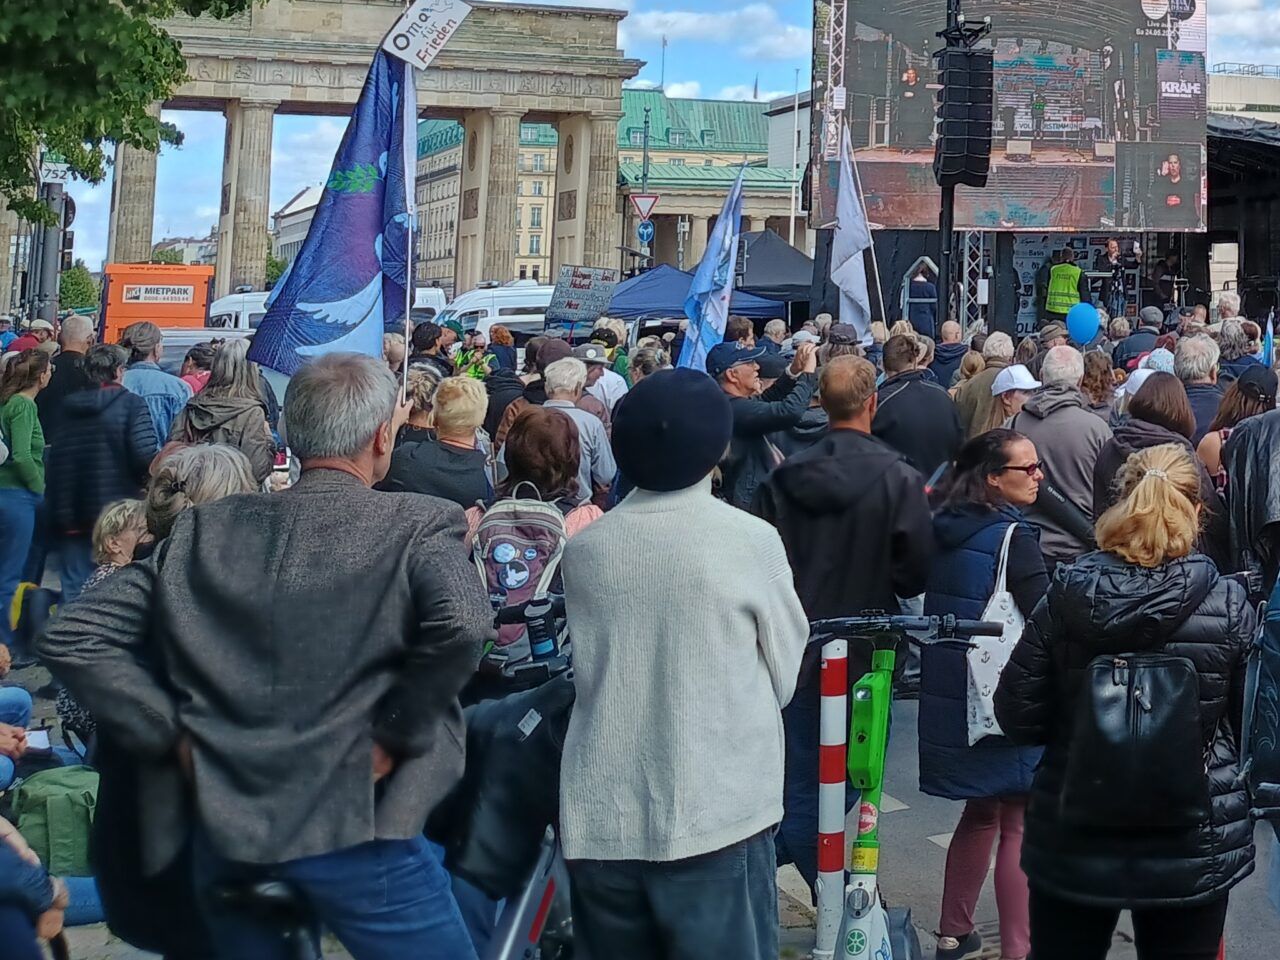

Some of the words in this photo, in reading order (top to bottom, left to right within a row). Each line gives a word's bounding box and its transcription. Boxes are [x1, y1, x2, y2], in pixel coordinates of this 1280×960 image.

[393, 12, 431, 51] Oma
[420, 21, 439, 39] für
[416, 19, 457, 64] Frieden
[45, 169, 67, 180] 752
[144, 287, 189, 295] MIETPARK
